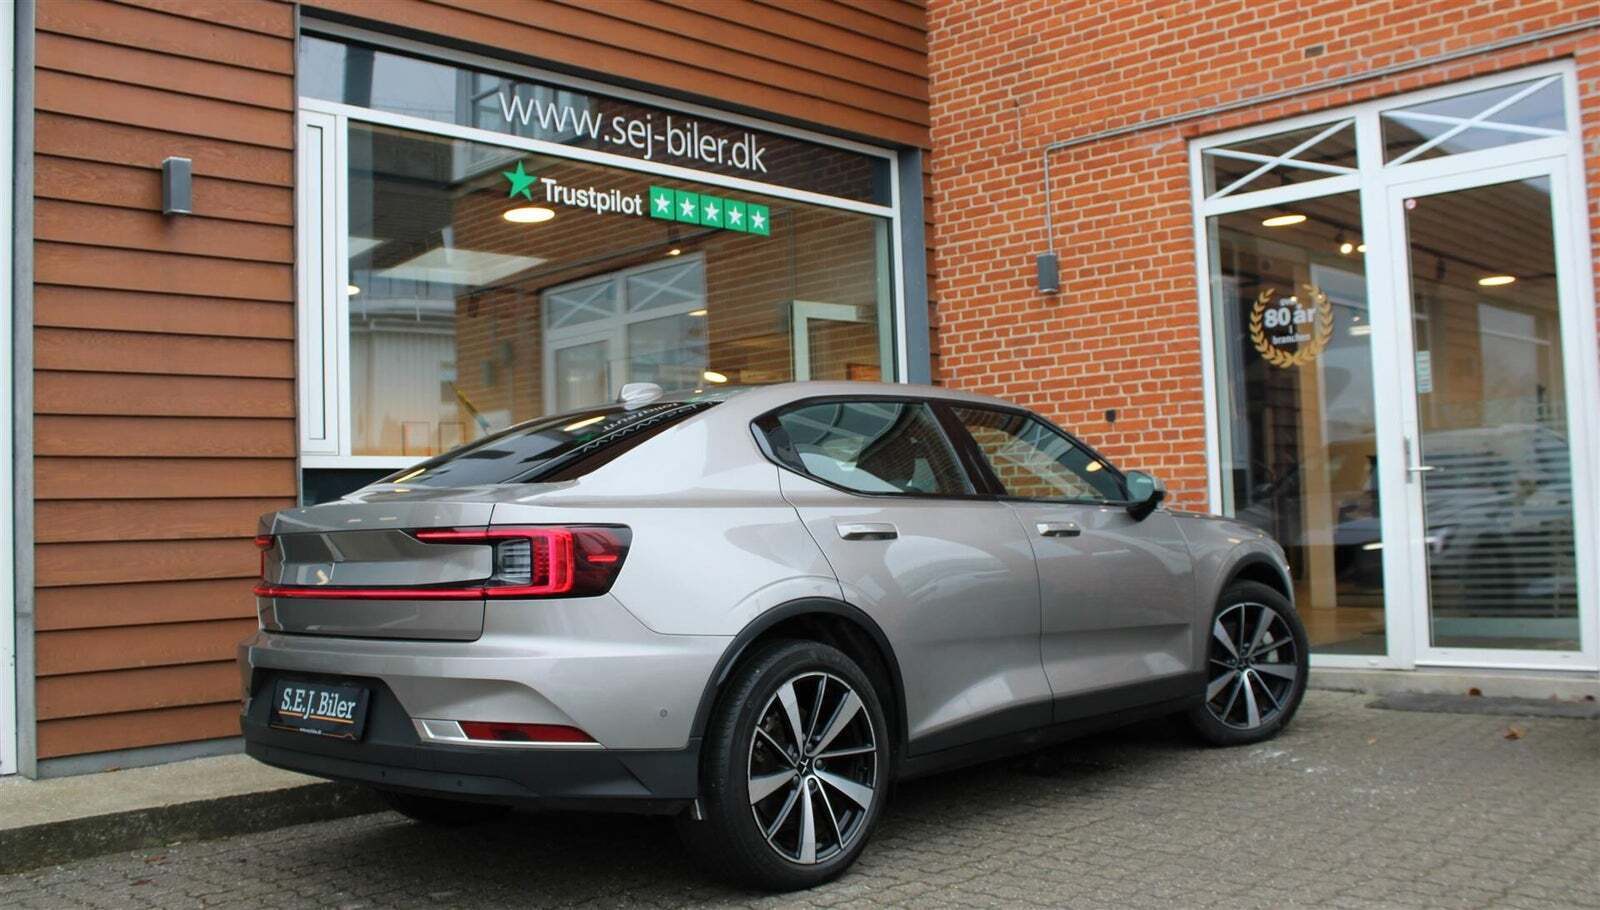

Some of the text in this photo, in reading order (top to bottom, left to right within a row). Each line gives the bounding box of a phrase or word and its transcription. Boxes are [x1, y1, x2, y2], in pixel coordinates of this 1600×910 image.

[499, 91, 767, 173] www.sej-biler.dk
[541, 177, 643, 216] Trustpilot
[1264, 303, 1317, 328] 80 år
[281, 687, 356, 720] S.E.J. Biler
